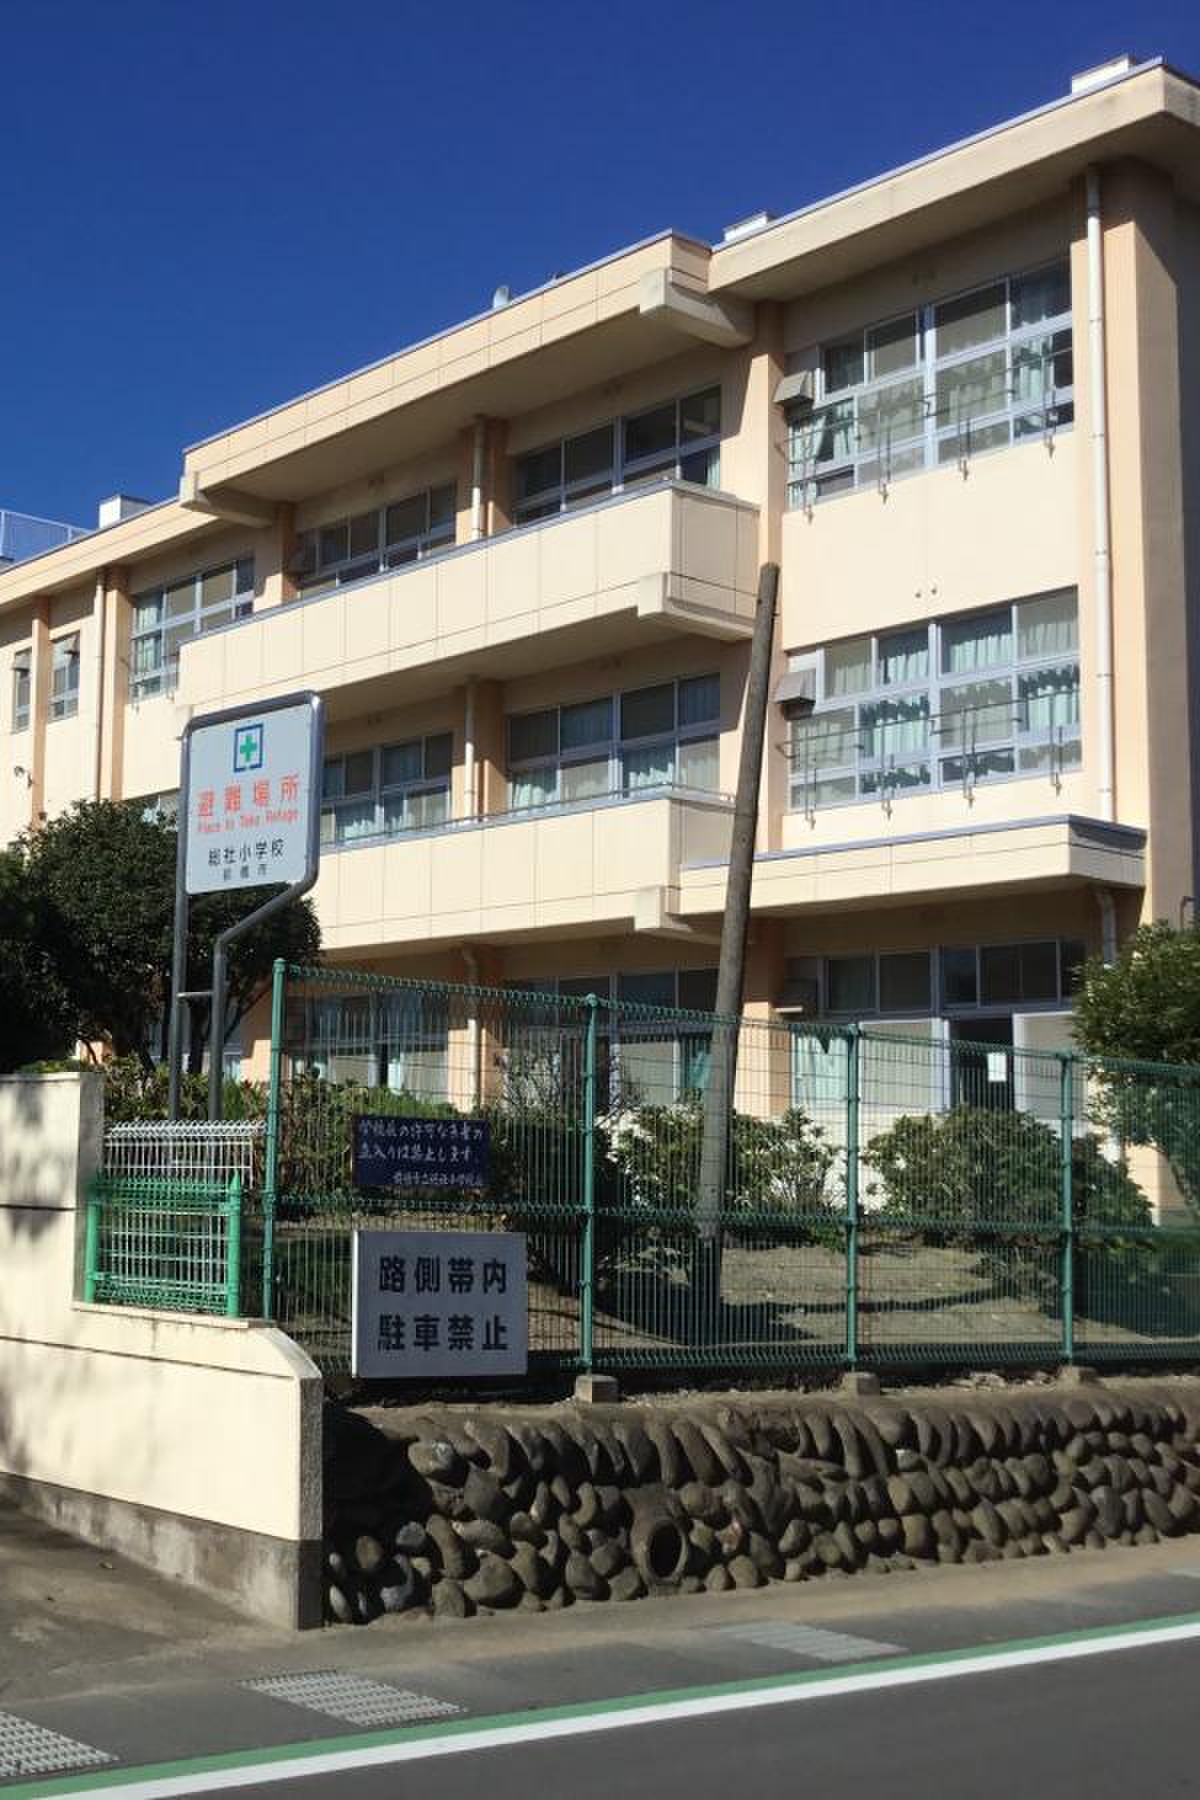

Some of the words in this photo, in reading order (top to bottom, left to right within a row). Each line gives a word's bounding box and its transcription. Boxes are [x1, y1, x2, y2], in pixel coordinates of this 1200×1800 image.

[197, 773, 299, 817] 避難場所
[208, 838, 285, 866] 総社小学校
[378, 1254, 507, 1294] 路側帯内
[377, 1313, 509, 1352] 駐車禁止
